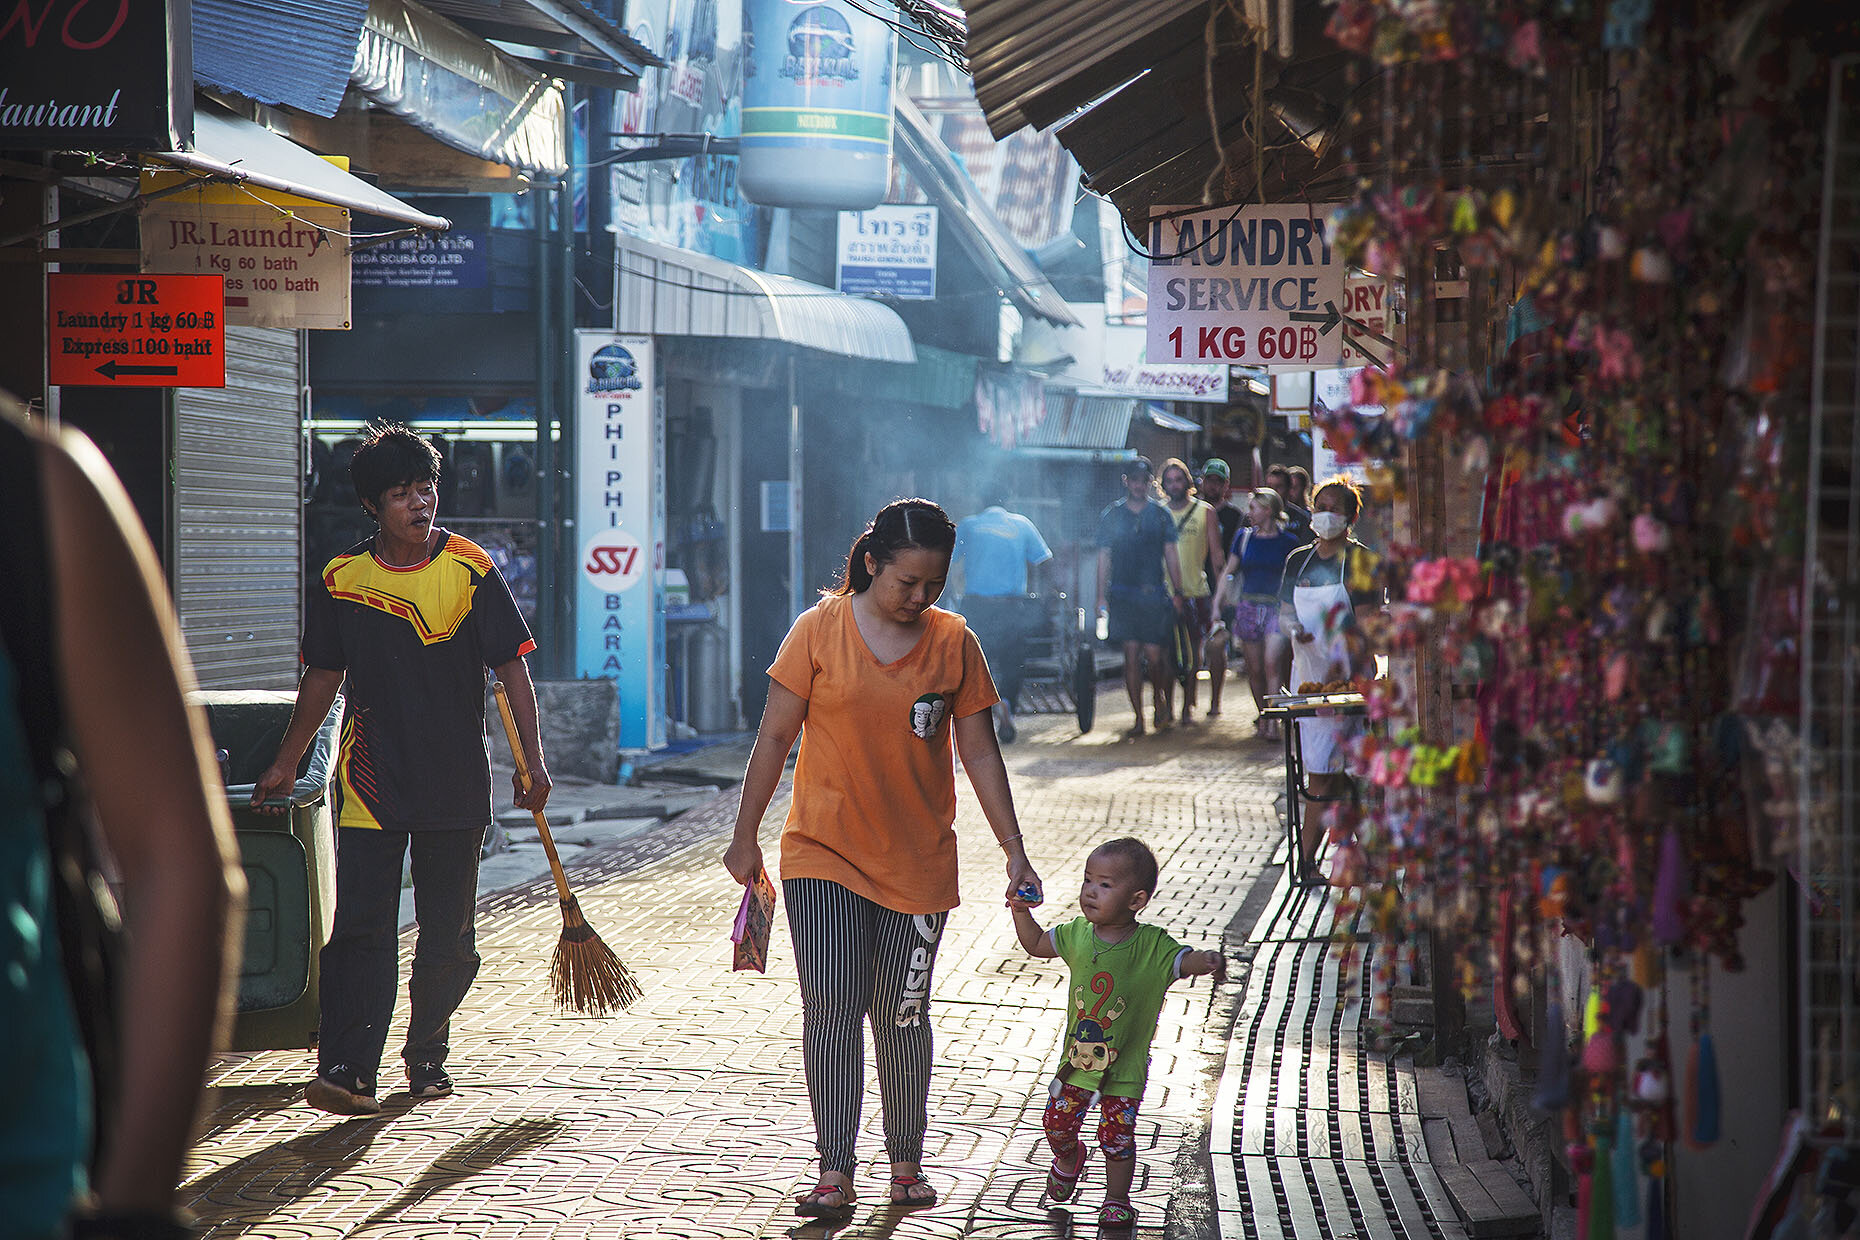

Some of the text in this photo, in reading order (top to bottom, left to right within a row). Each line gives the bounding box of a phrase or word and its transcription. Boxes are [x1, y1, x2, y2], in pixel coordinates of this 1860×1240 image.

[1152, 218, 1333, 266] LAUNDRY
[210, 255, 231, 271] Kg
[239, 257, 256, 269] 60
[263, 256, 298, 271] bath
[117, 279, 159, 305] JR
[252, 278, 278, 291] 100
[285, 277, 319, 292] bath
[1166, 277, 1320, 312] SERVICE
[57, 311, 128, 333] Laundry
[151, 311, 171, 333] kg
[62, 337, 213, 359] Express 100 baht
[1168, 326, 1183, 358] 1
[1199, 326, 1246, 359] KG
[605, 404, 622, 459] PHI
[604, 471, 622, 527] PHI
[586, 546, 639, 575] SSI
[603, 594, 622, 679] BARA
[896, 947, 932, 1028] asics
